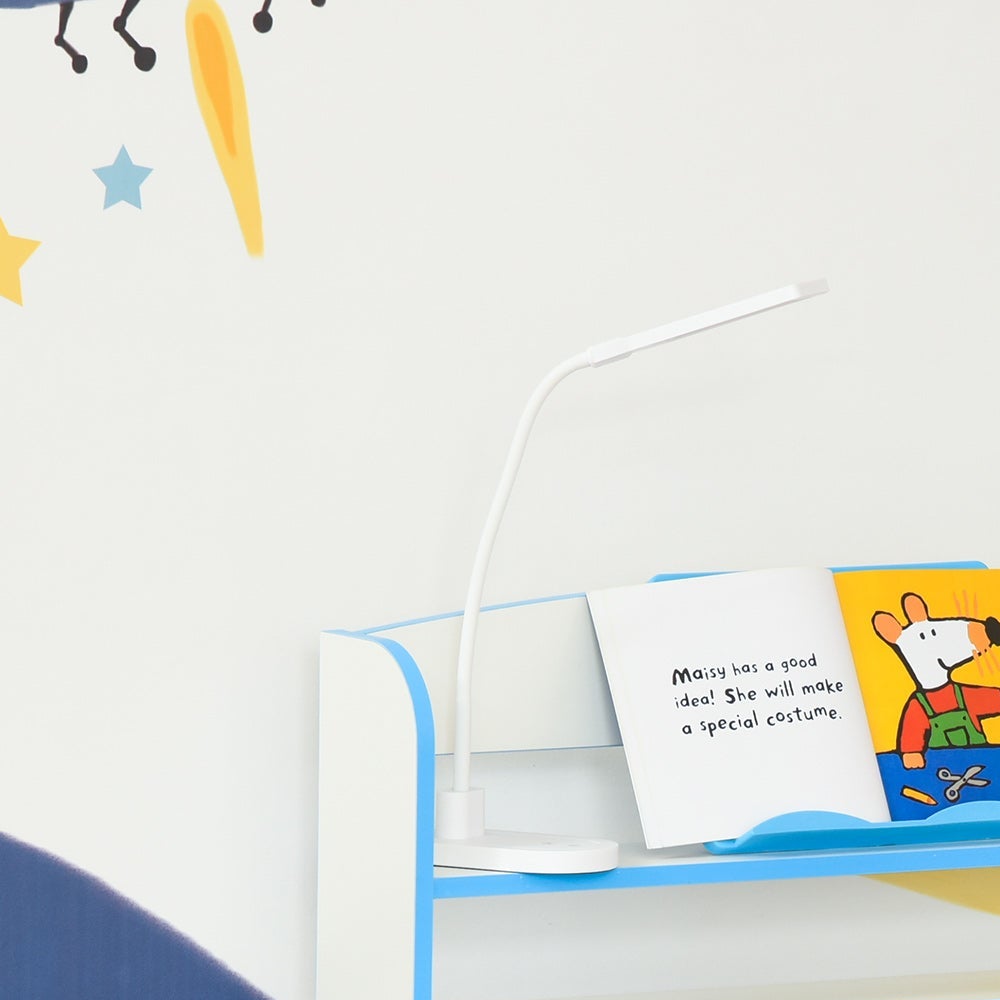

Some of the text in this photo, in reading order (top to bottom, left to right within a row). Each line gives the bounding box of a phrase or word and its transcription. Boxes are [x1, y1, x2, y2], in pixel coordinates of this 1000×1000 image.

[672, 653, 817, 686] Maisy has a good
[674, 678, 843, 708] idea! She will make
[682, 707, 842, 737] a special costume.
